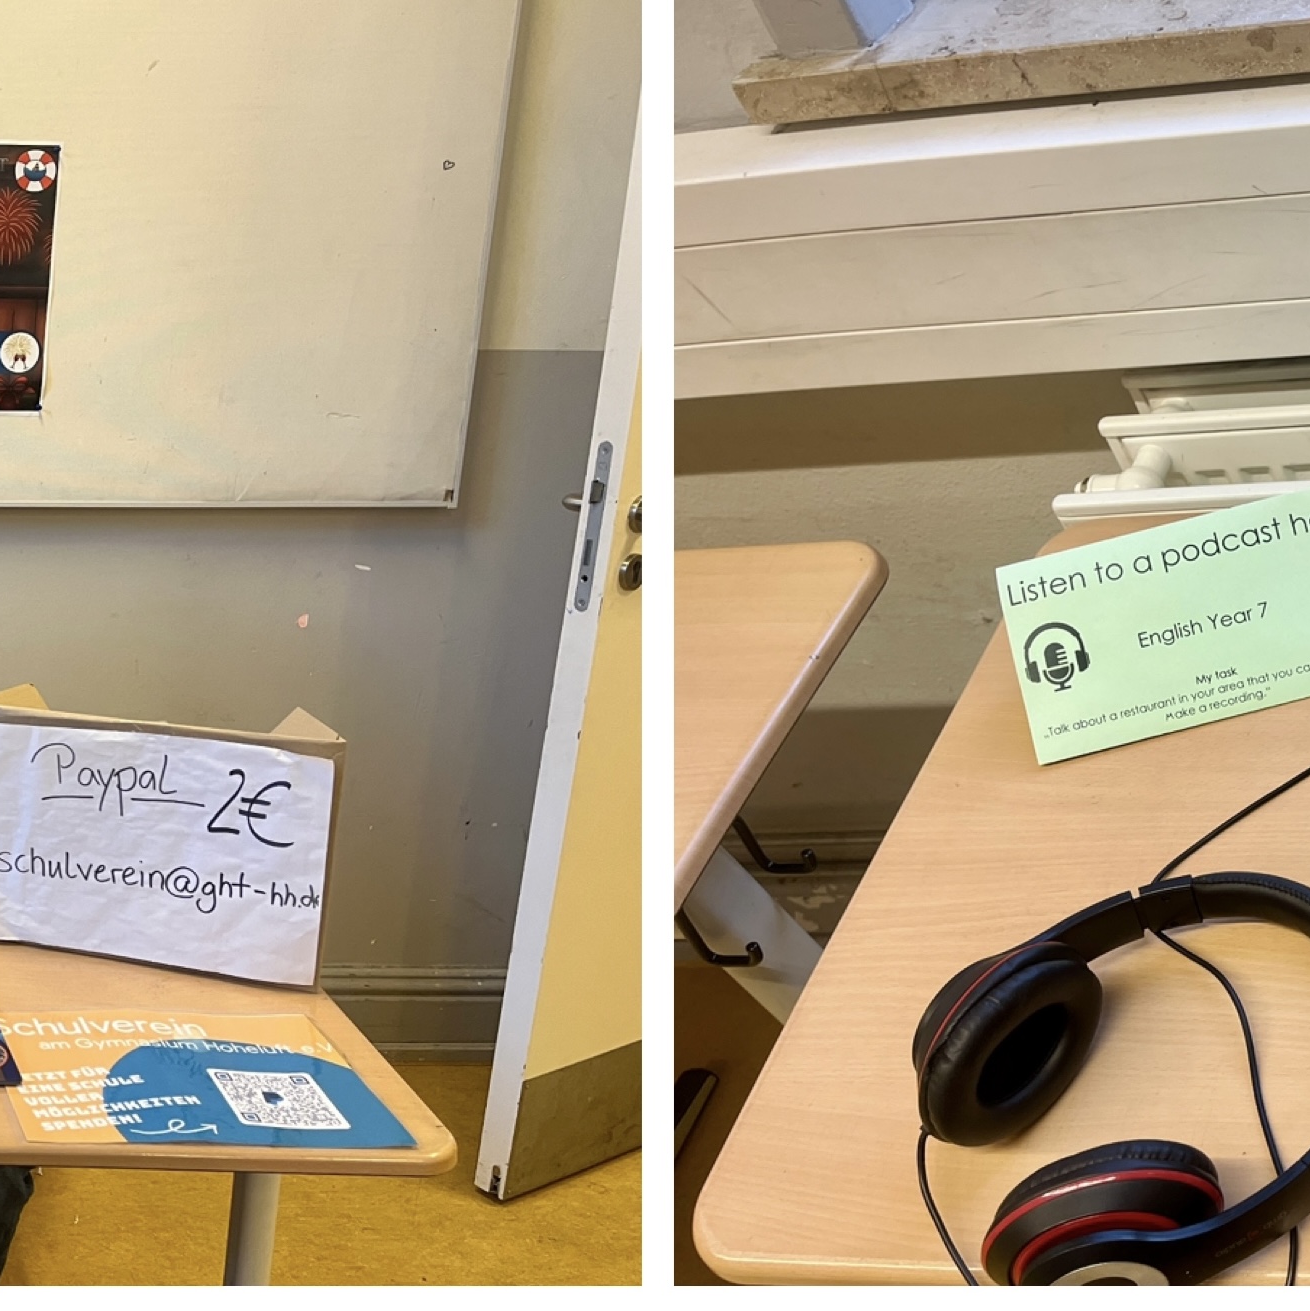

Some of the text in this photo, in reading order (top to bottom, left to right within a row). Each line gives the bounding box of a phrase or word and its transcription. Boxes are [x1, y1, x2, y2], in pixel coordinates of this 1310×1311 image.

[1007, 569, 1087, 607] Listen
[1095, 560, 1123, 584] to
[1133, 554, 1154, 574] a
[1161, 517, 1282, 573] podcast
[1137, 601, 1268, 649] English Year 7
[1195, 667, 1238, 686] My task
[1073, 713, 1108, 731] about
[1109, 711, 1119, 721] a
[1120, 696, 1177, 719] restaurant
[1179, 692, 1188, 704] in
[1190, 686, 1215, 703] your
[1218, 679, 1245, 693] area
[1247, 672, 1270, 686] that
[1271, 669, 1293, 683] you
[1165, 705, 1196, 721] Make
[1199, 702, 1208, 713] a
[31, 743, 294, 847] Paypal 2€
[0, 1017, 207, 1037] Schulverein
[39, 1039, 70, 1051] am
[75, 1037, 197, 1052] Gymnasium
[203, 1041, 293, 1055] Hoheluft
[71, 1066, 110, 1078] FÜR
[18, 1075, 145, 1095] EINE SCHULE
[24, 1091, 103, 1106] VOLLER
[32, 1096, 201, 1119] MÖGLICHKEITEN
[41, 1113, 143, 1131] SPENDEN!
